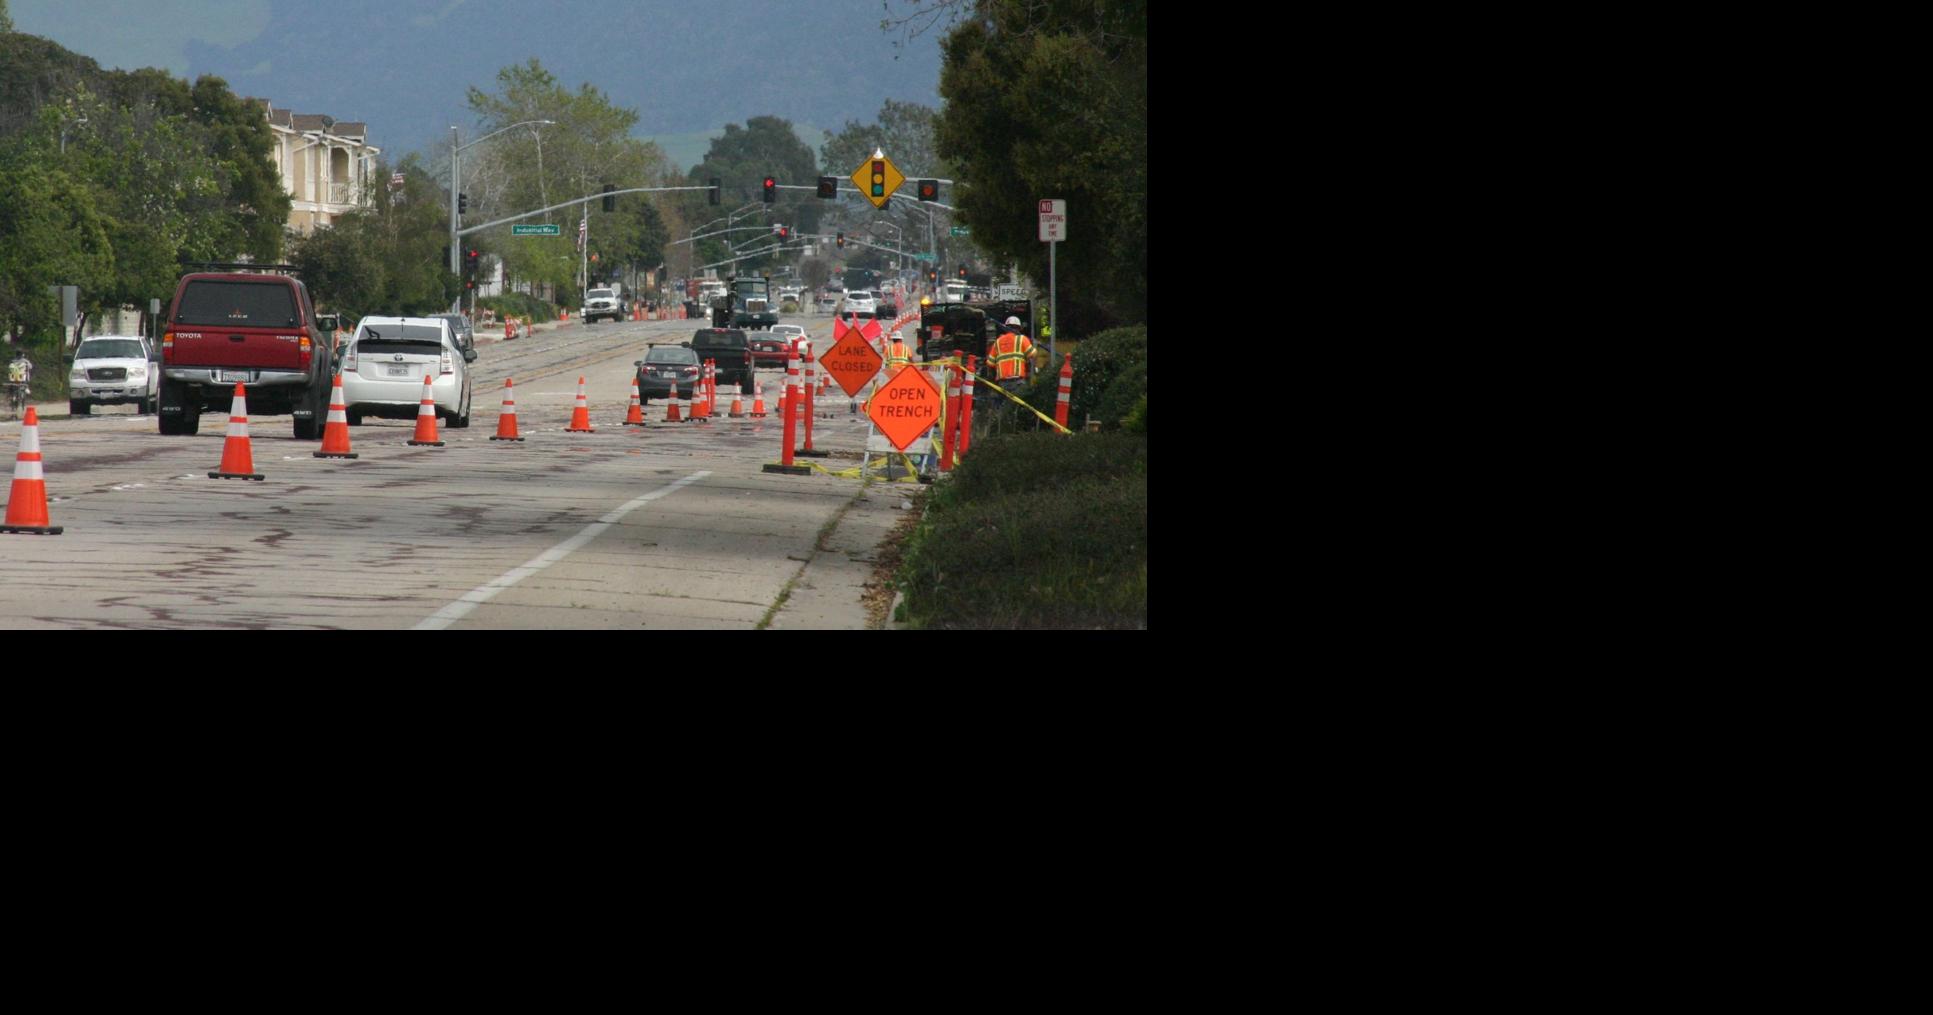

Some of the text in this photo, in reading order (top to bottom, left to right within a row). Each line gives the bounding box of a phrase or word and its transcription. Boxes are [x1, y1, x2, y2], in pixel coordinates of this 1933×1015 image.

[1041, 202, 1051, 212] NO
[838, 346, 867, 356] LANE
[831, 361, 873, 373] CLOSED
[889, 388, 925, 400] OPEN
[879, 405, 933, 418] TRENCH
